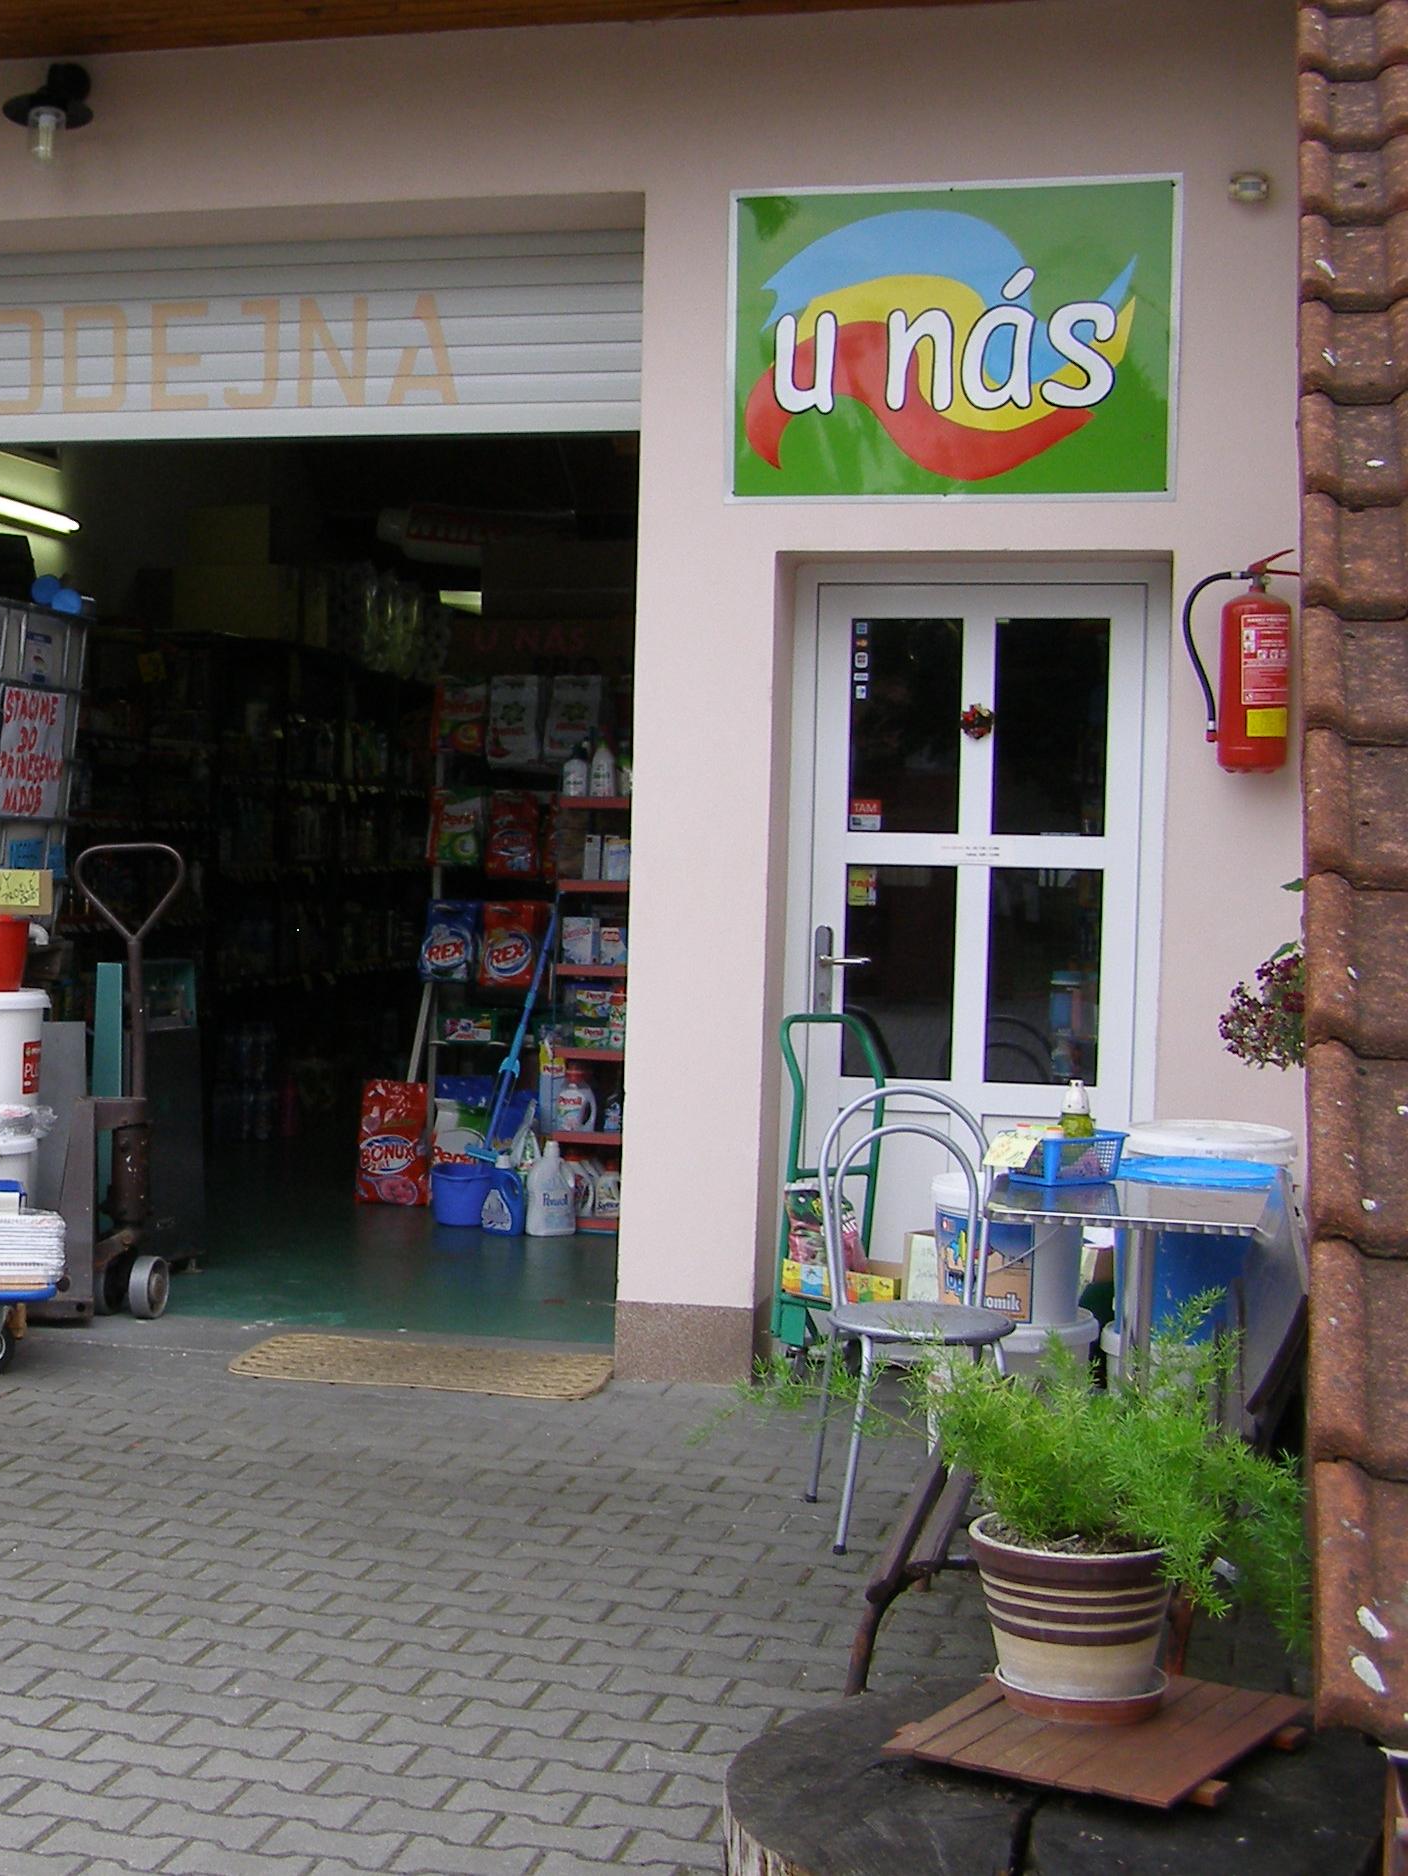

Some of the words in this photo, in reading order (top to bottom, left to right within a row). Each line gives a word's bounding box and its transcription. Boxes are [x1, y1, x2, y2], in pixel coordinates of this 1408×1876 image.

[773, 310, 837, 414] u
[886, 266, 1117, 411] nás
[427, 940, 465, 962] REX
[491, 942, 526, 964] REX
[559, 1095, 584, 1106] Persil
[360, 1142, 416, 1168] BONUX
